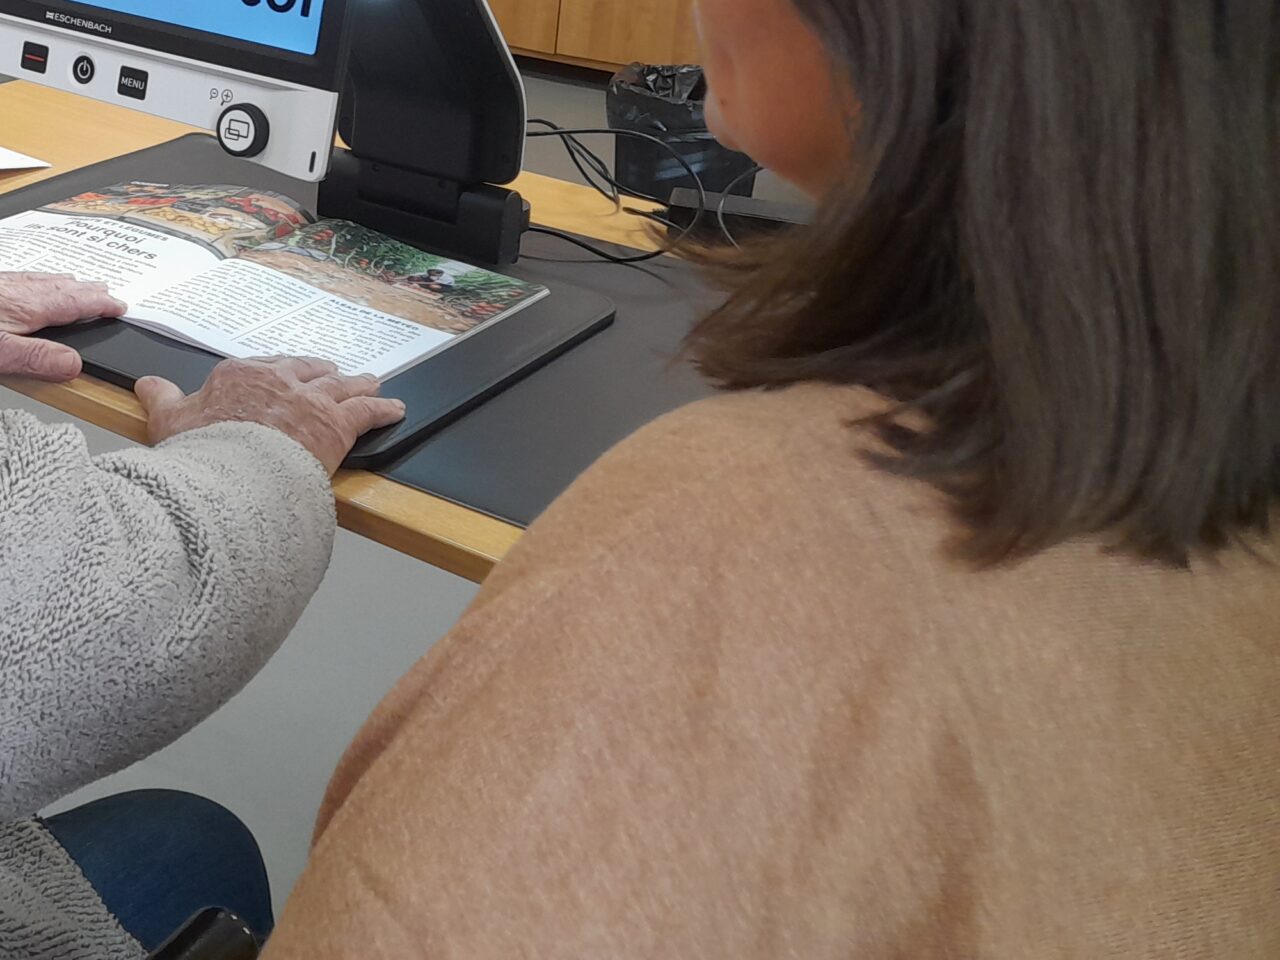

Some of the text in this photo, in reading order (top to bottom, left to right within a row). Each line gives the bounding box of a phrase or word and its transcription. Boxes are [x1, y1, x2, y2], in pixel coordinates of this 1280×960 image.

[54, 13, 112, 34] ESCHENBACH
[120, 75, 145, 90] MENU
[46, 225, 87, 238] sont
[86, 234, 108, 244] si
[106, 241, 158, 261] chers
[64, 220, 147, 244] Pourquoi
